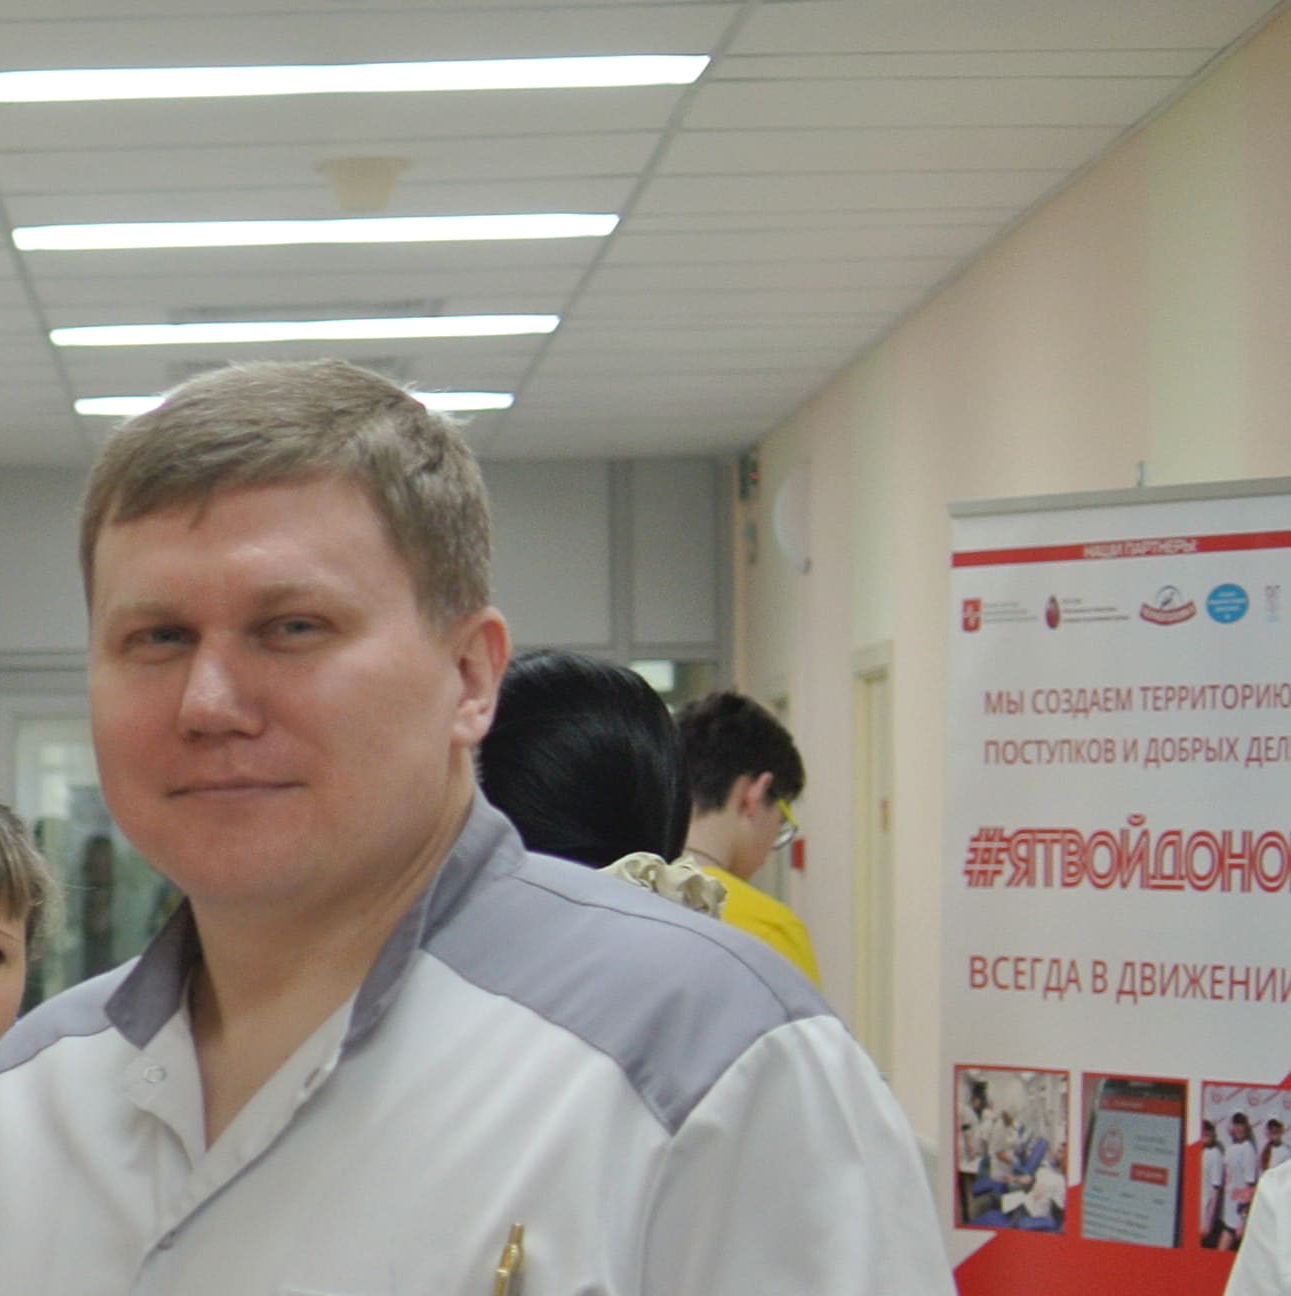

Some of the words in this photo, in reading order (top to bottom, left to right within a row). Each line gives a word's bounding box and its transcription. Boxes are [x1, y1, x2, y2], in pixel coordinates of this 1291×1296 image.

[984, 690, 1024, 715] МЫ
[1030, 687, 1133, 718] СОЗДАЕМ
[1138, 682, 1291, 713] ТЕРРИТОРИЮ
[983, 738, 1116, 765] ПОСТУПКОВ
[1122, 738, 1139, 763] И
[1144, 736, 1240, 768] ДОБРЫХ
[963, 813, 1291, 893] #ЯТВОЙДОНО
[970, 955, 1082, 1000] ВСЕГДА
[1091, 960, 1108, 994] В
